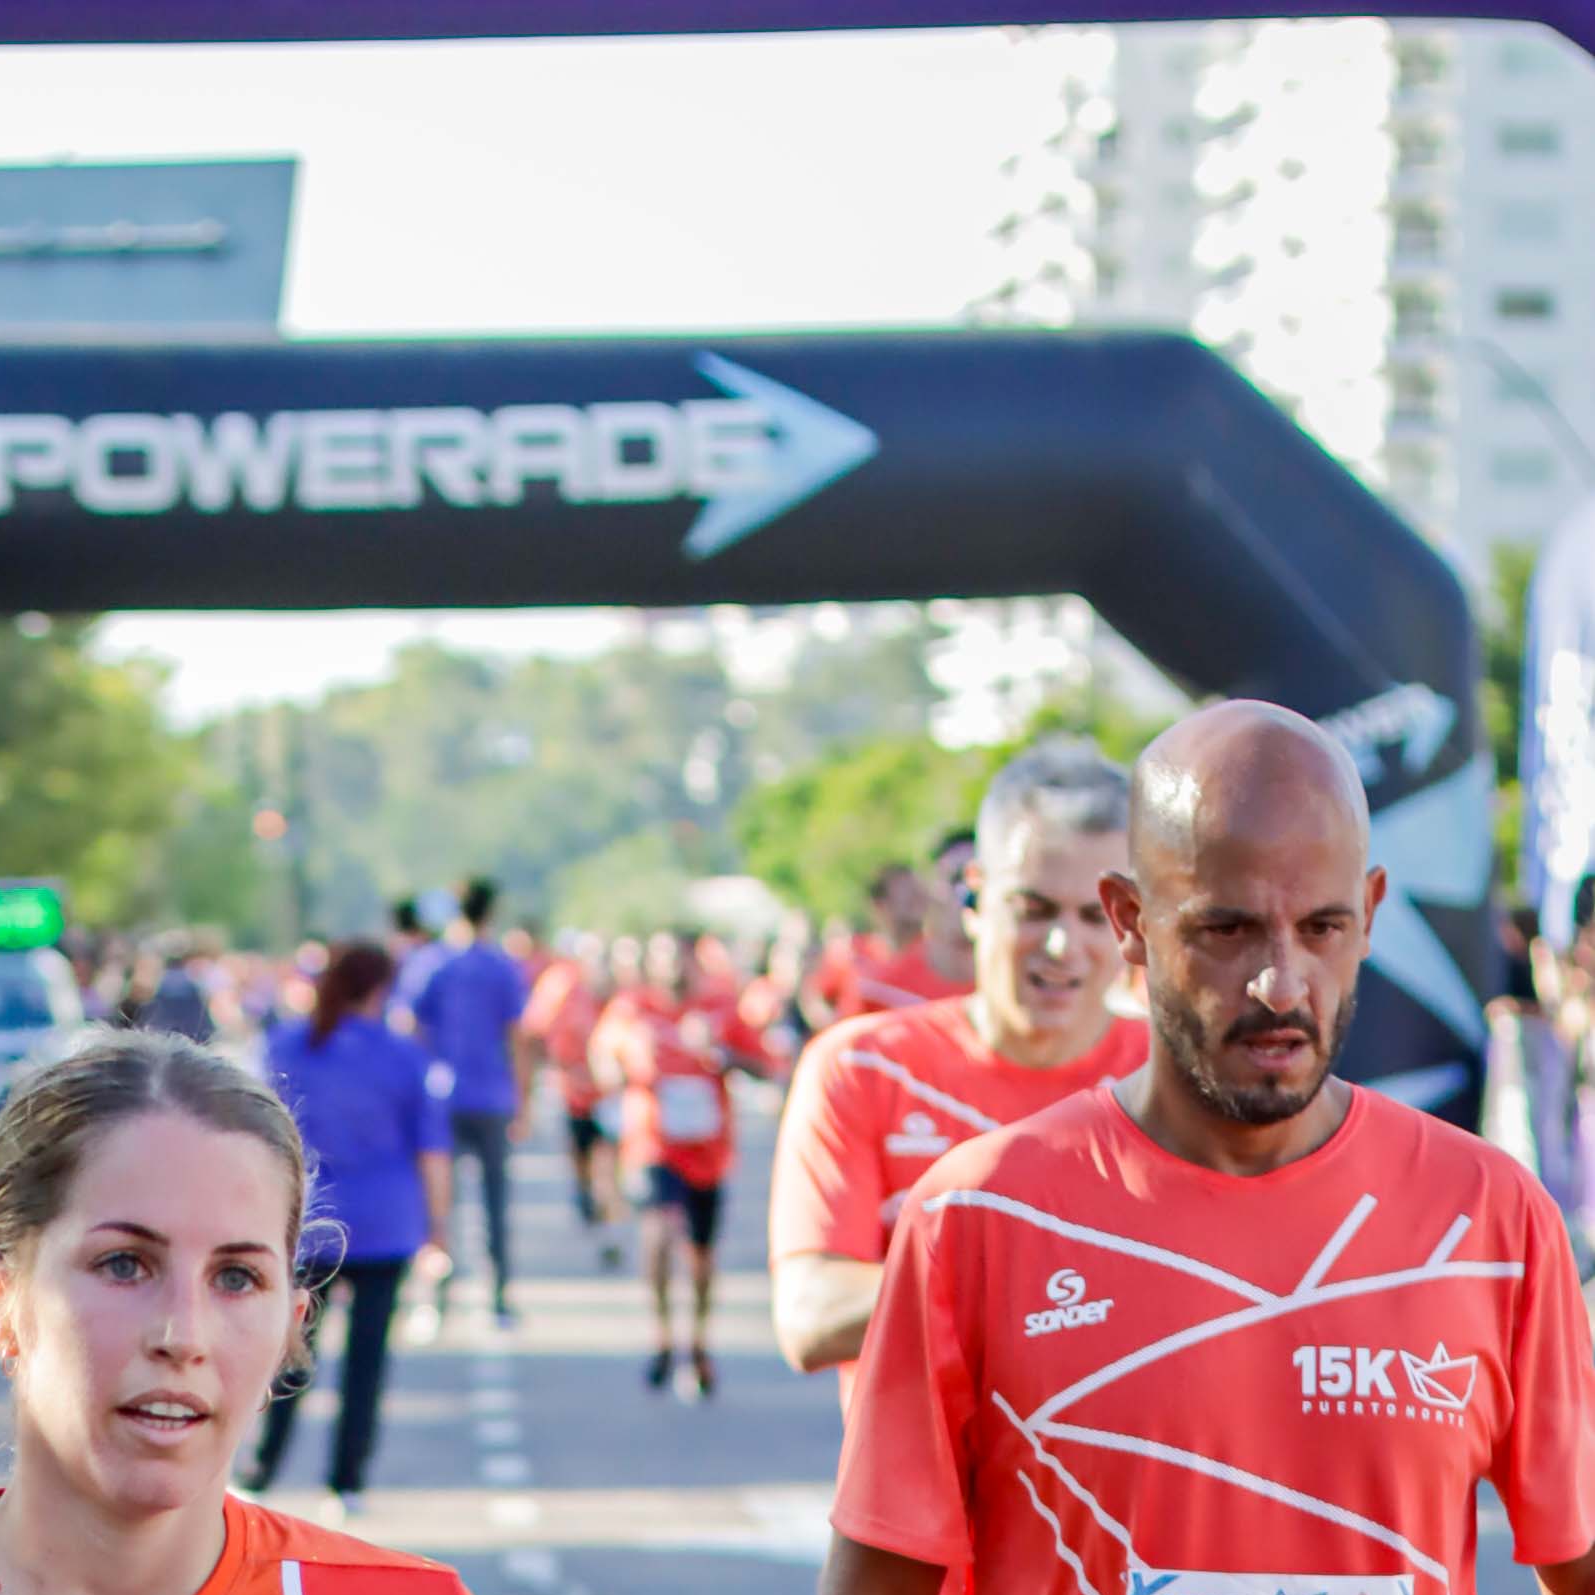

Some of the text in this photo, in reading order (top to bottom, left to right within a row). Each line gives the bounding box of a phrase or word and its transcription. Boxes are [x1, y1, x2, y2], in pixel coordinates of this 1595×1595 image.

[1292, 1344, 1397, 1399] 15K
[1302, 1400, 1465, 1429] PUERTO NORTE
